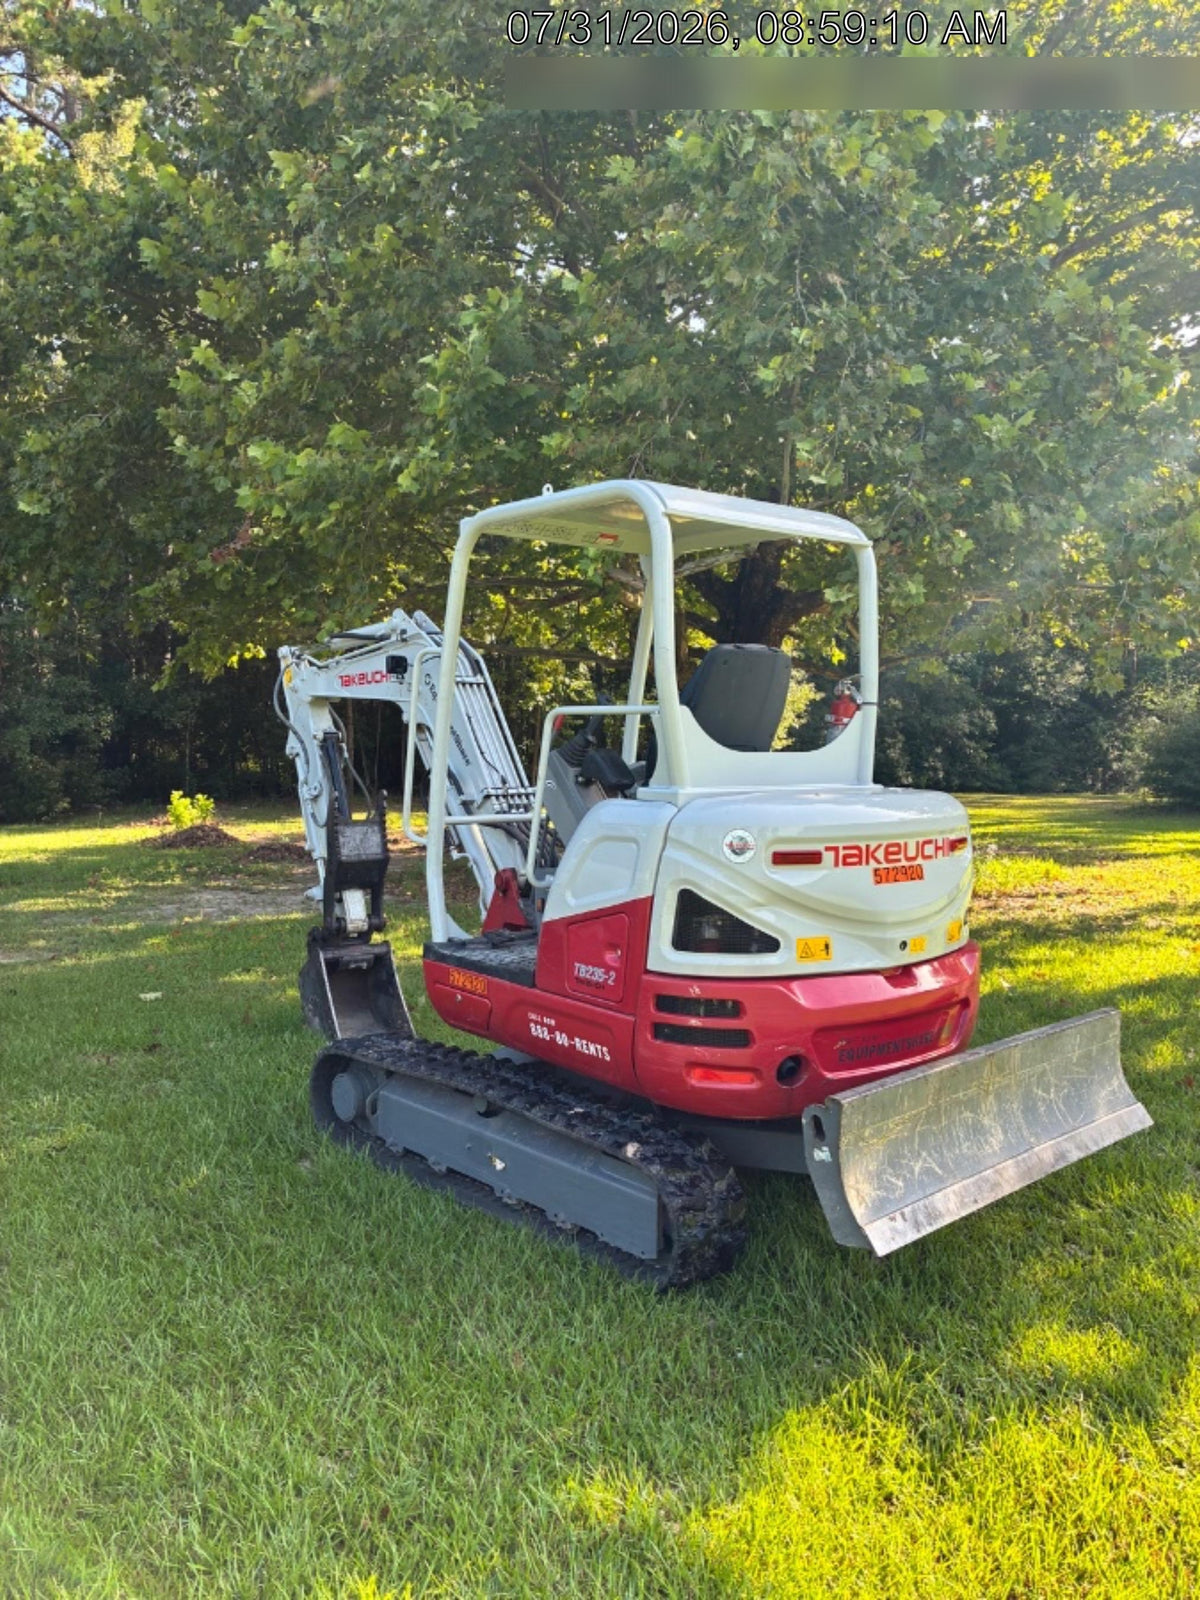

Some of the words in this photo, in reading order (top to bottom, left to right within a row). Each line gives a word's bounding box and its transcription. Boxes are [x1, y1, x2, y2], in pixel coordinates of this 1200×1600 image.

[873, 864, 924, 885] 572920
[574, 961, 616, 985] TB235-2
[529, 1022, 611, 1061] 888-80-RENTS
